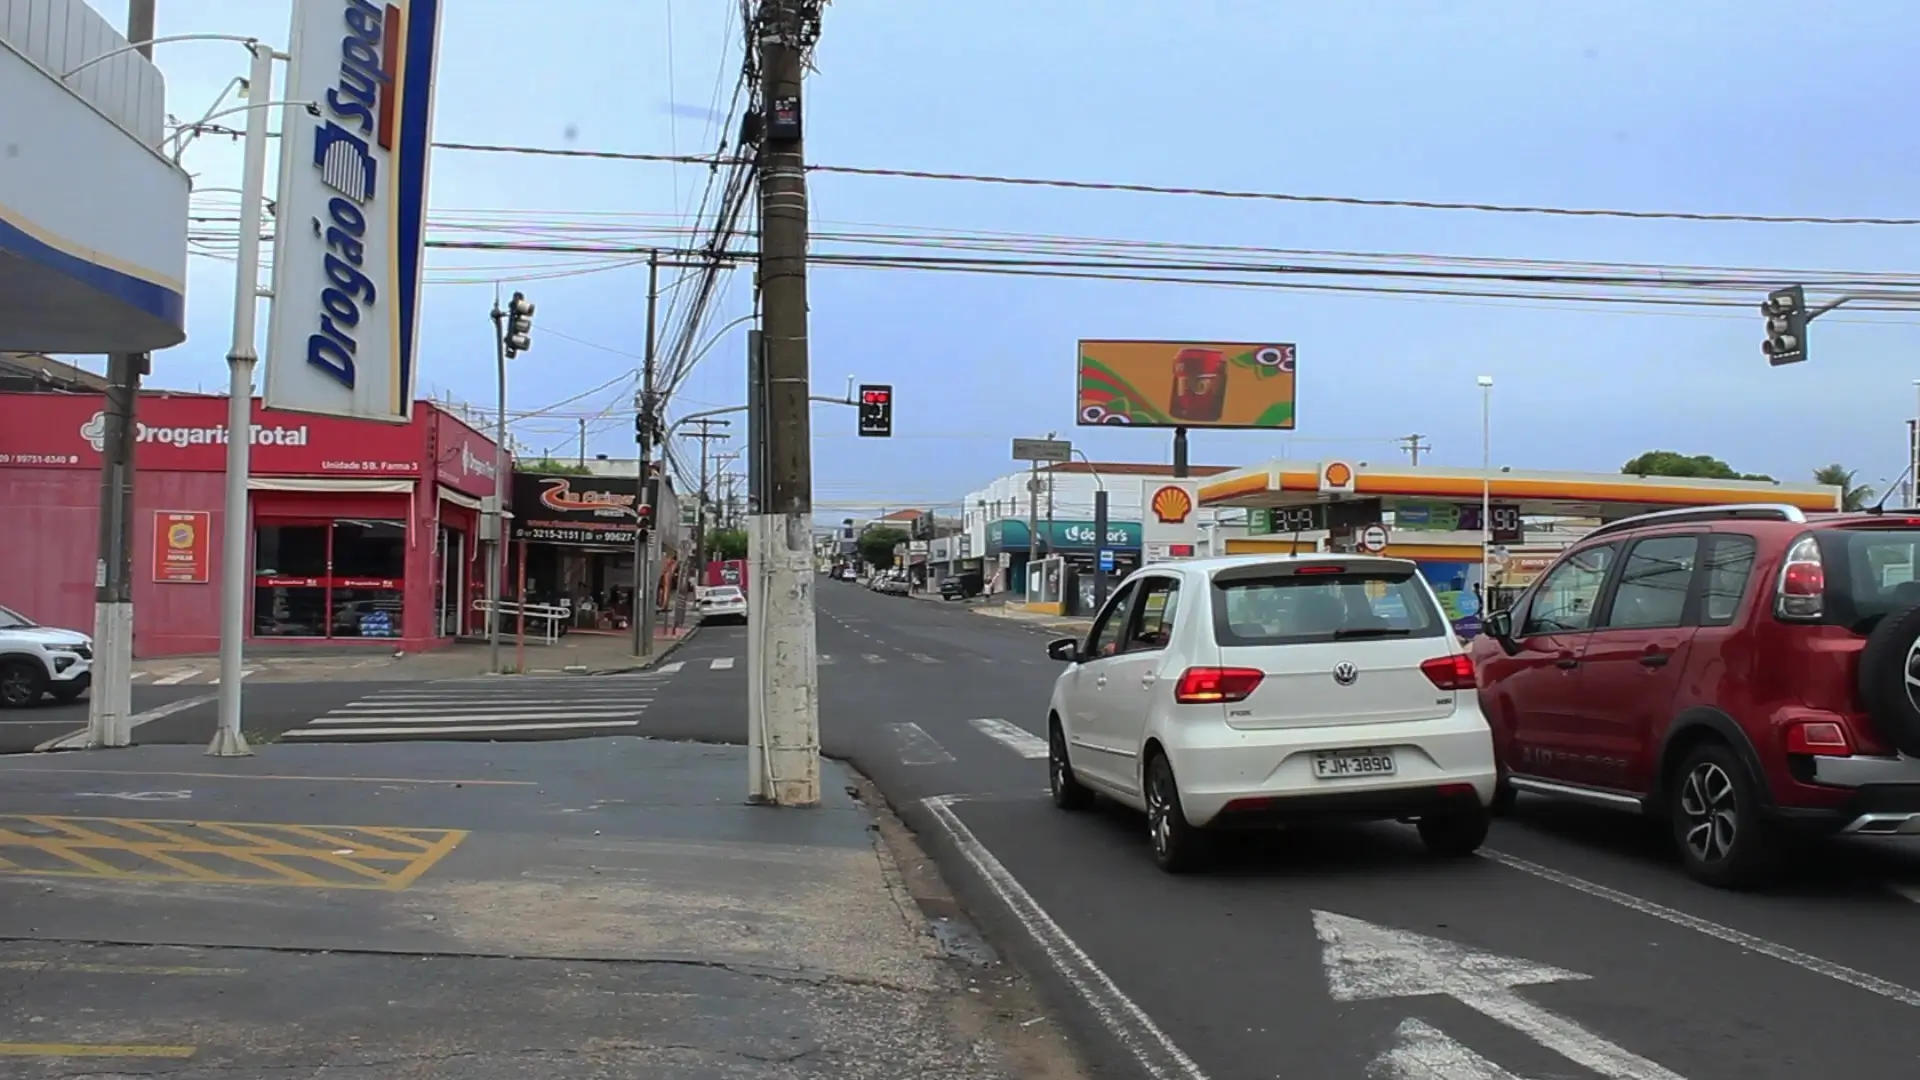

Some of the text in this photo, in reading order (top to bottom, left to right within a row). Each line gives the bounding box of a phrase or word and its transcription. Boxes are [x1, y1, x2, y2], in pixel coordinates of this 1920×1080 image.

[307, 197, 377, 390] Drogão
[249, 425, 307, 446] Total
[1250, 510, 1265, 526] E
[1080, 527, 1128, 542] door's
